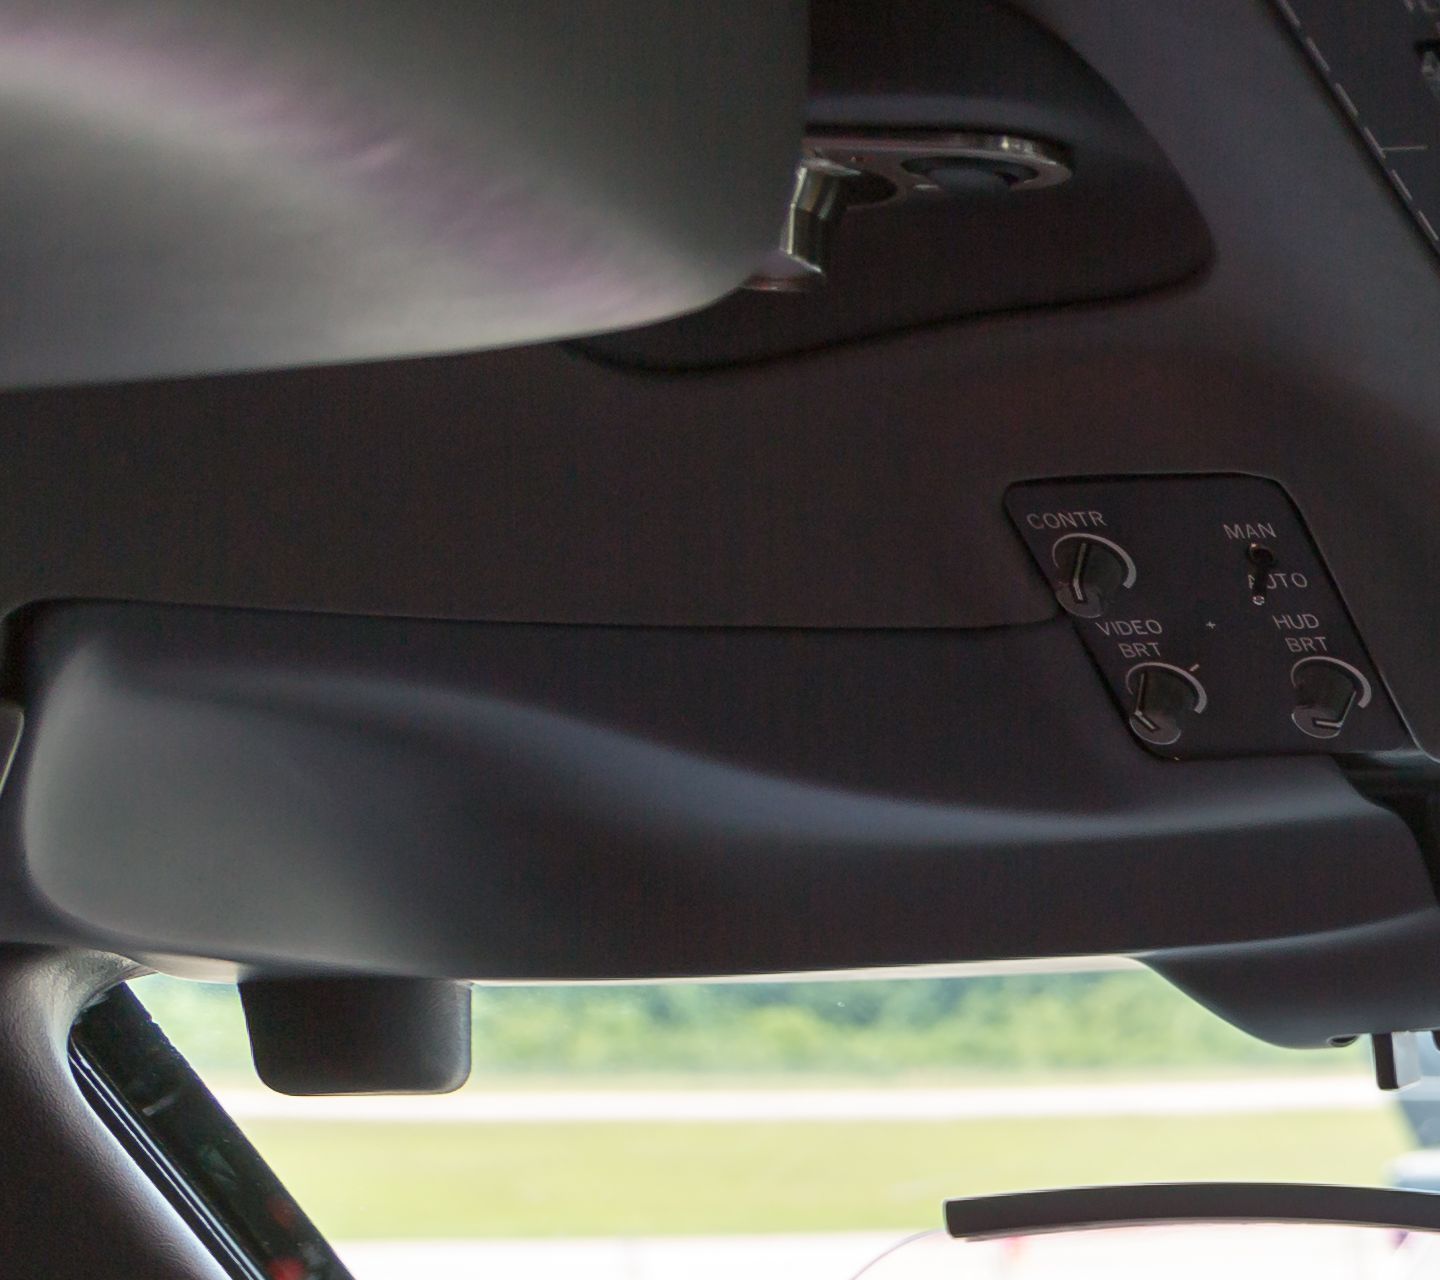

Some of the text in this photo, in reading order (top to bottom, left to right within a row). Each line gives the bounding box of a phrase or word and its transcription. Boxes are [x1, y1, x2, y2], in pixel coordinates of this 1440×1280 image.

[1025, 509, 1109, 530] CONTR
[1223, 521, 1277, 541] MAN
[1095, 618, 1163, 638] VIDEO
[1271, 612, 1320, 632] HUD
[1117, 641, 1162, 660] BRT
[1284, 635, 1328, 654] BRT
